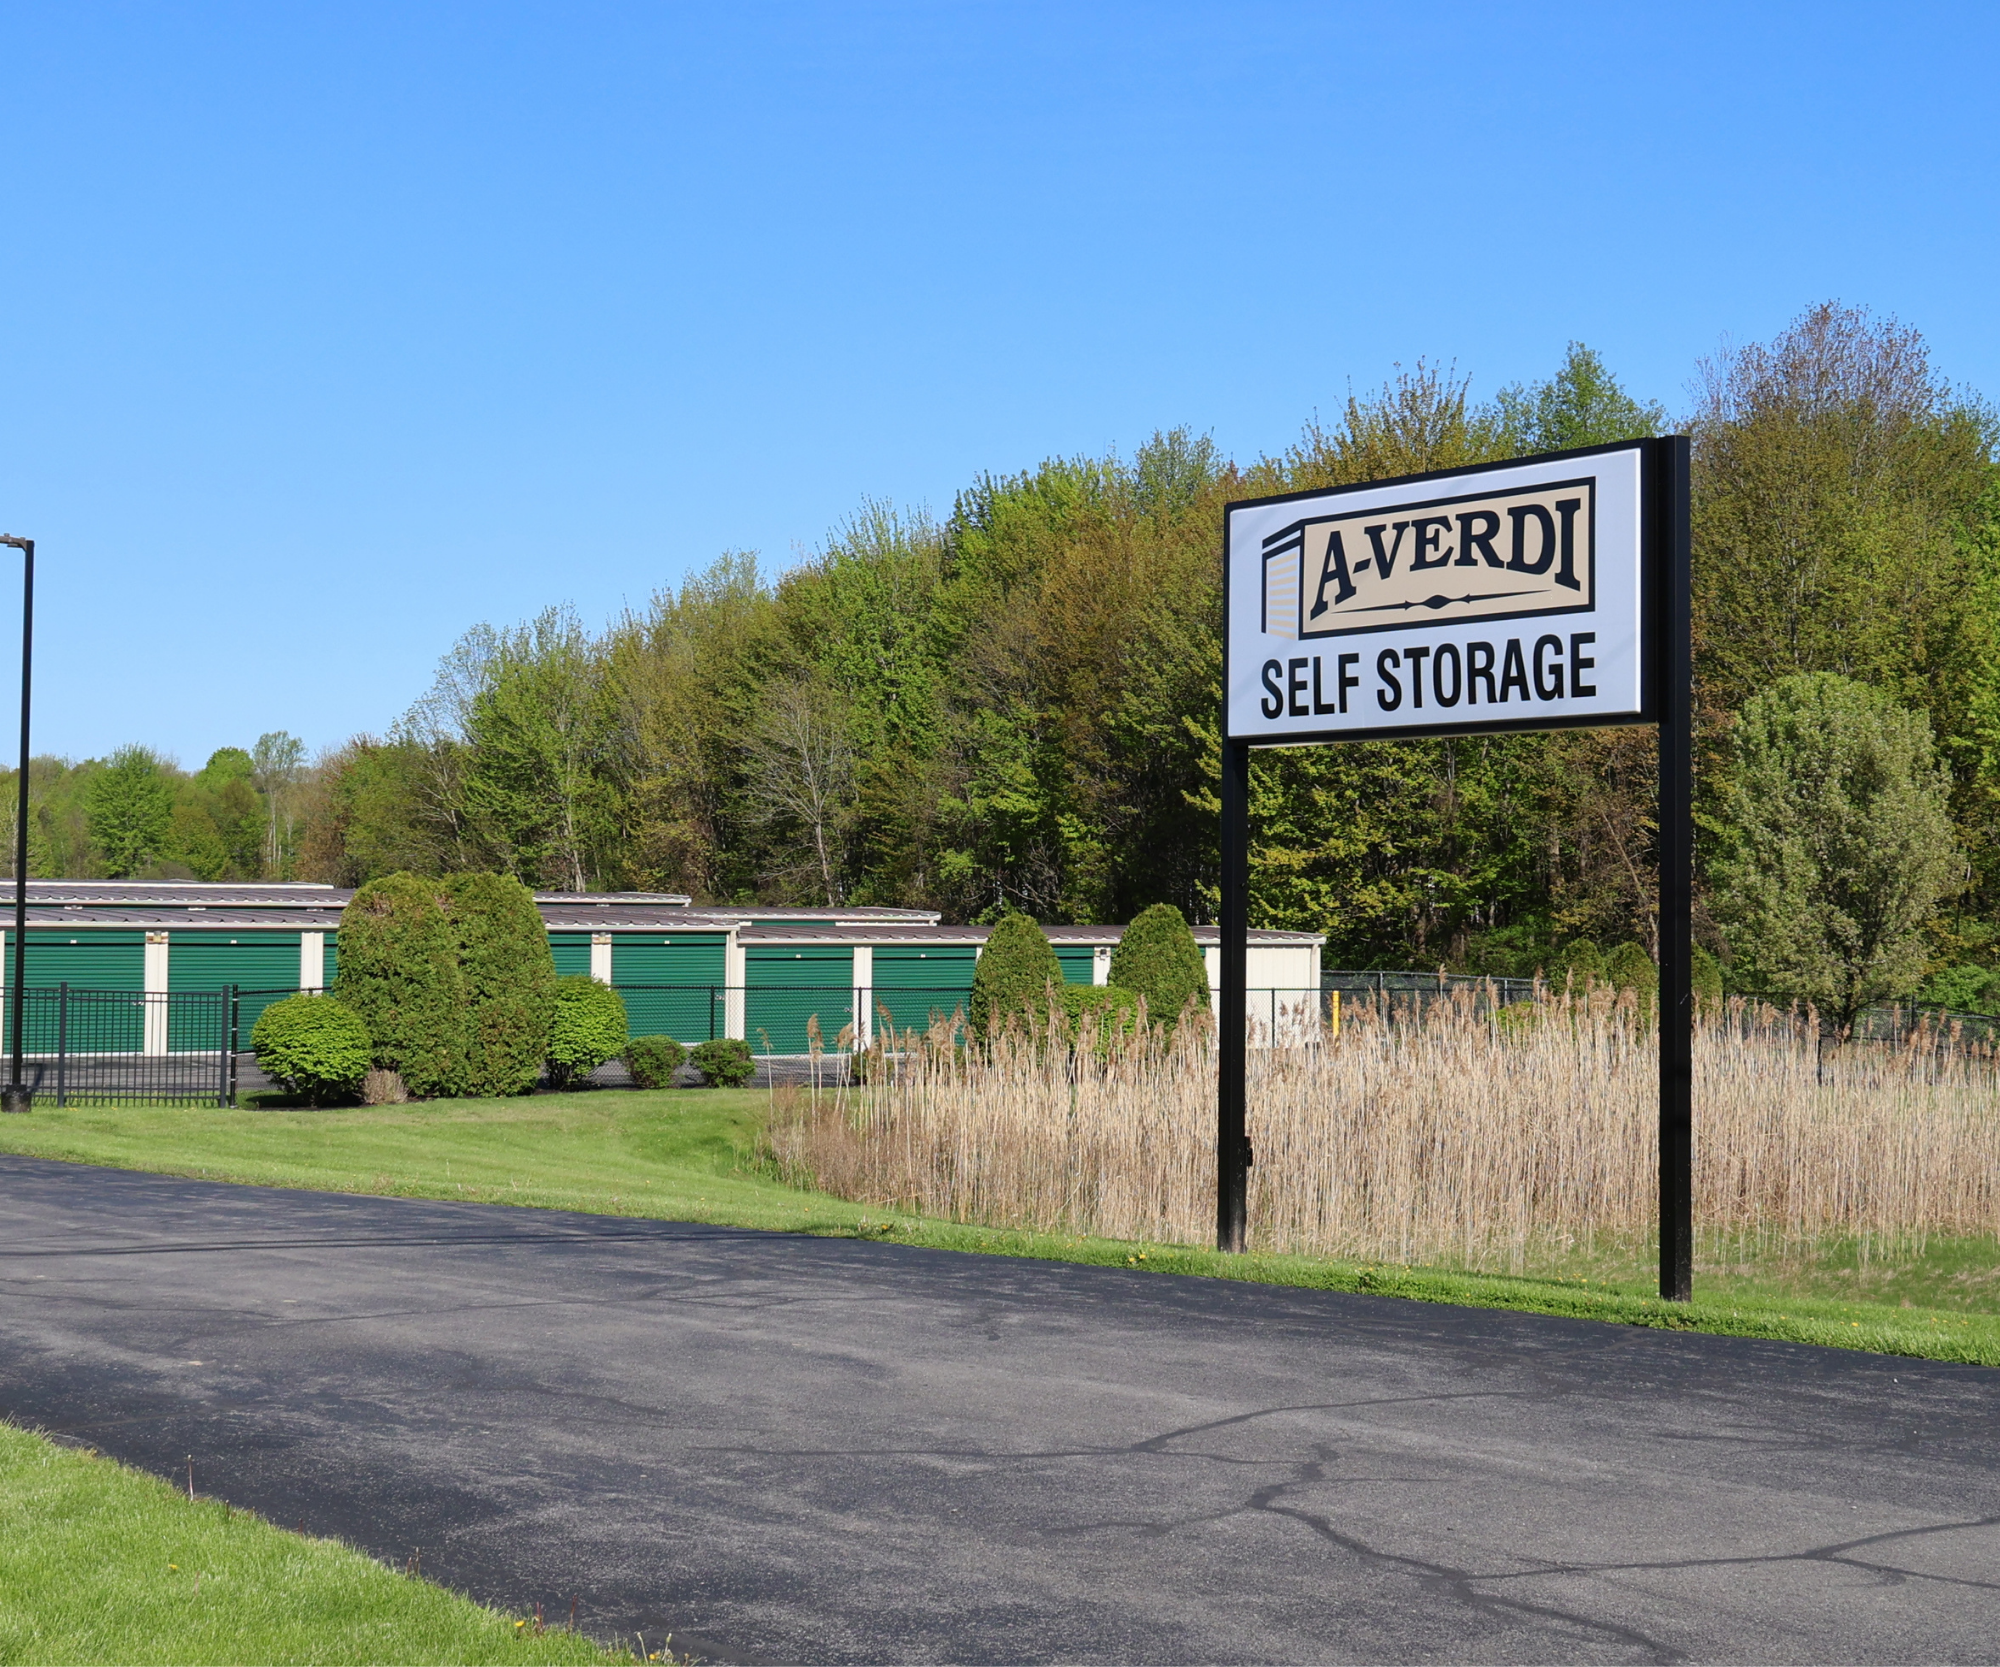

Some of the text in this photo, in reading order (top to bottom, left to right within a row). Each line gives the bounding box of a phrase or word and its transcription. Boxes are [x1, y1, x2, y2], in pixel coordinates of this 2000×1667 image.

[1310, 498, 1581, 620] A-VERDI
[1261, 632, 1596, 719] SELF STORAGE
